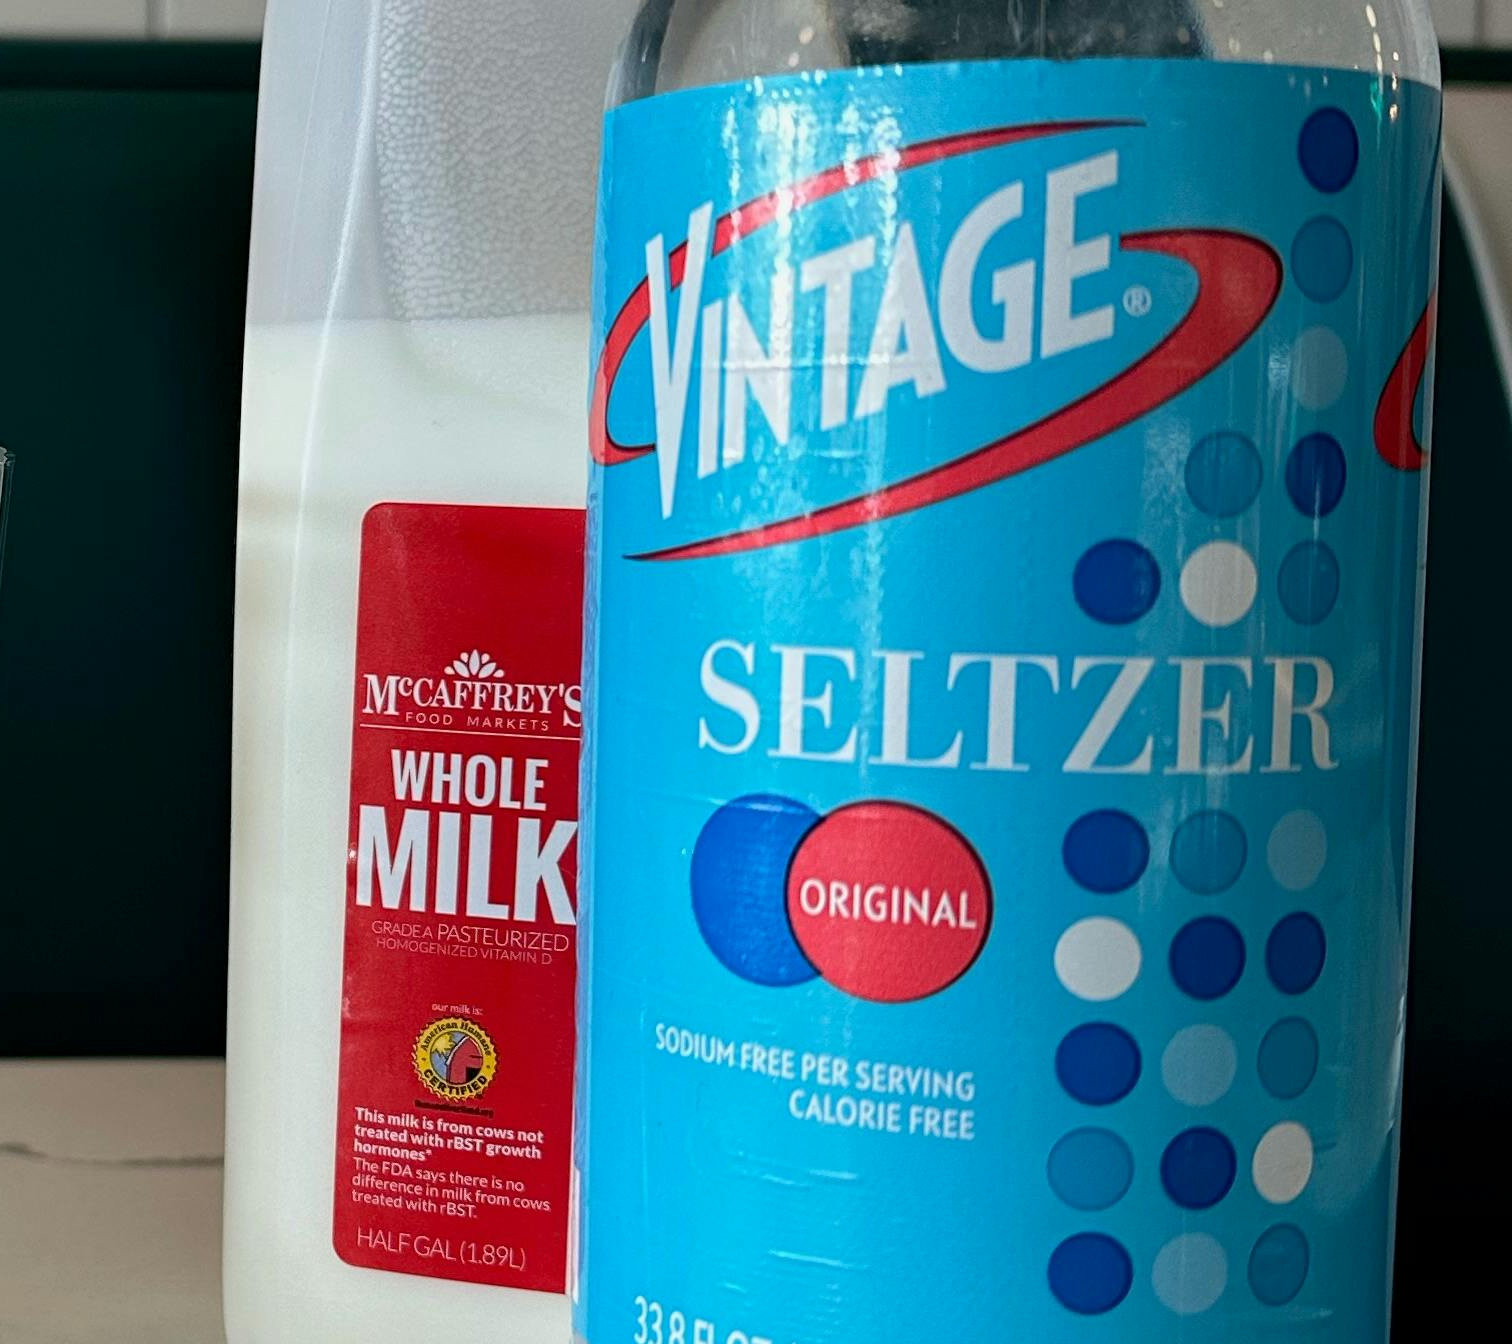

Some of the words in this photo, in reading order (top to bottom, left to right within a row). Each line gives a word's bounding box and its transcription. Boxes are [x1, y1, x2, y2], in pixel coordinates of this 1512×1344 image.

[405, 711, 453, 725] FOOD
[467, 716, 549, 731] MARKETS
[699, 637, 1340, 777] SELTZER
[390, 748, 549, 811] WHOLE
[356, 804, 578, 926] MILK
[799, 876, 977, 932] ORIGINAL
[372, 920, 420, 937] GRADE
[437, 923, 570, 952] PASTEURIZED
[376, 937, 478, 958] HOMOGENIZED
[480, 948, 537, 964] VITAMIN
[541, 952, 553, 965] D
[431, 1003, 448, 1012] our
[450, 1004, 470, 1015] milk
[655, 1023, 735, 1069] SODIUM
[740, 1042, 795, 1080] FREE
[801, 1052, 849, 1088] PER
[855, 1059, 975, 1102] SERVING
[424, 1069, 487, 1095] CERTIFIED
[355, 1106, 385, 1123] This
[388, 1111, 419, 1129] milk
[422, 1116, 434, 1130] is
[437, 1118, 473, 1136] from
[476, 1126, 514, 1140] cows
[517, 1129, 545, 1144] not
[789, 1088, 902, 1133] CALORIE
[909, 1106, 975, 1140] FREE
[354, 1124, 408, 1143] treated
[409, 1131, 444, 1148] with
[447, 1137, 484, 1152] rBST
[485, 1142, 542, 1159] growth
[352, 1173, 423, 1195] difference
[426, 1183, 438, 1197] in
[442, 1186, 472, 1202] milk
[475, 1191, 510, 1206] from
[513, 1197, 551, 1212] cows
[353, 1157, 378, 1173] The
[381, 1161, 413, 1178] FDA
[416, 1169, 446, 1184] says
[449, 1171, 488, 1187] there
[491, 1175, 503, 1189] is
[505, 1179, 525, 1192] no
[351, 1189, 402, 1208] treated
[405, 1196, 437, 1213] with
[357, 1227, 410, 1253] HALF
[414, 1235, 456, 1262] GAL
[460, 1240, 526, 1272] (1.89L)
